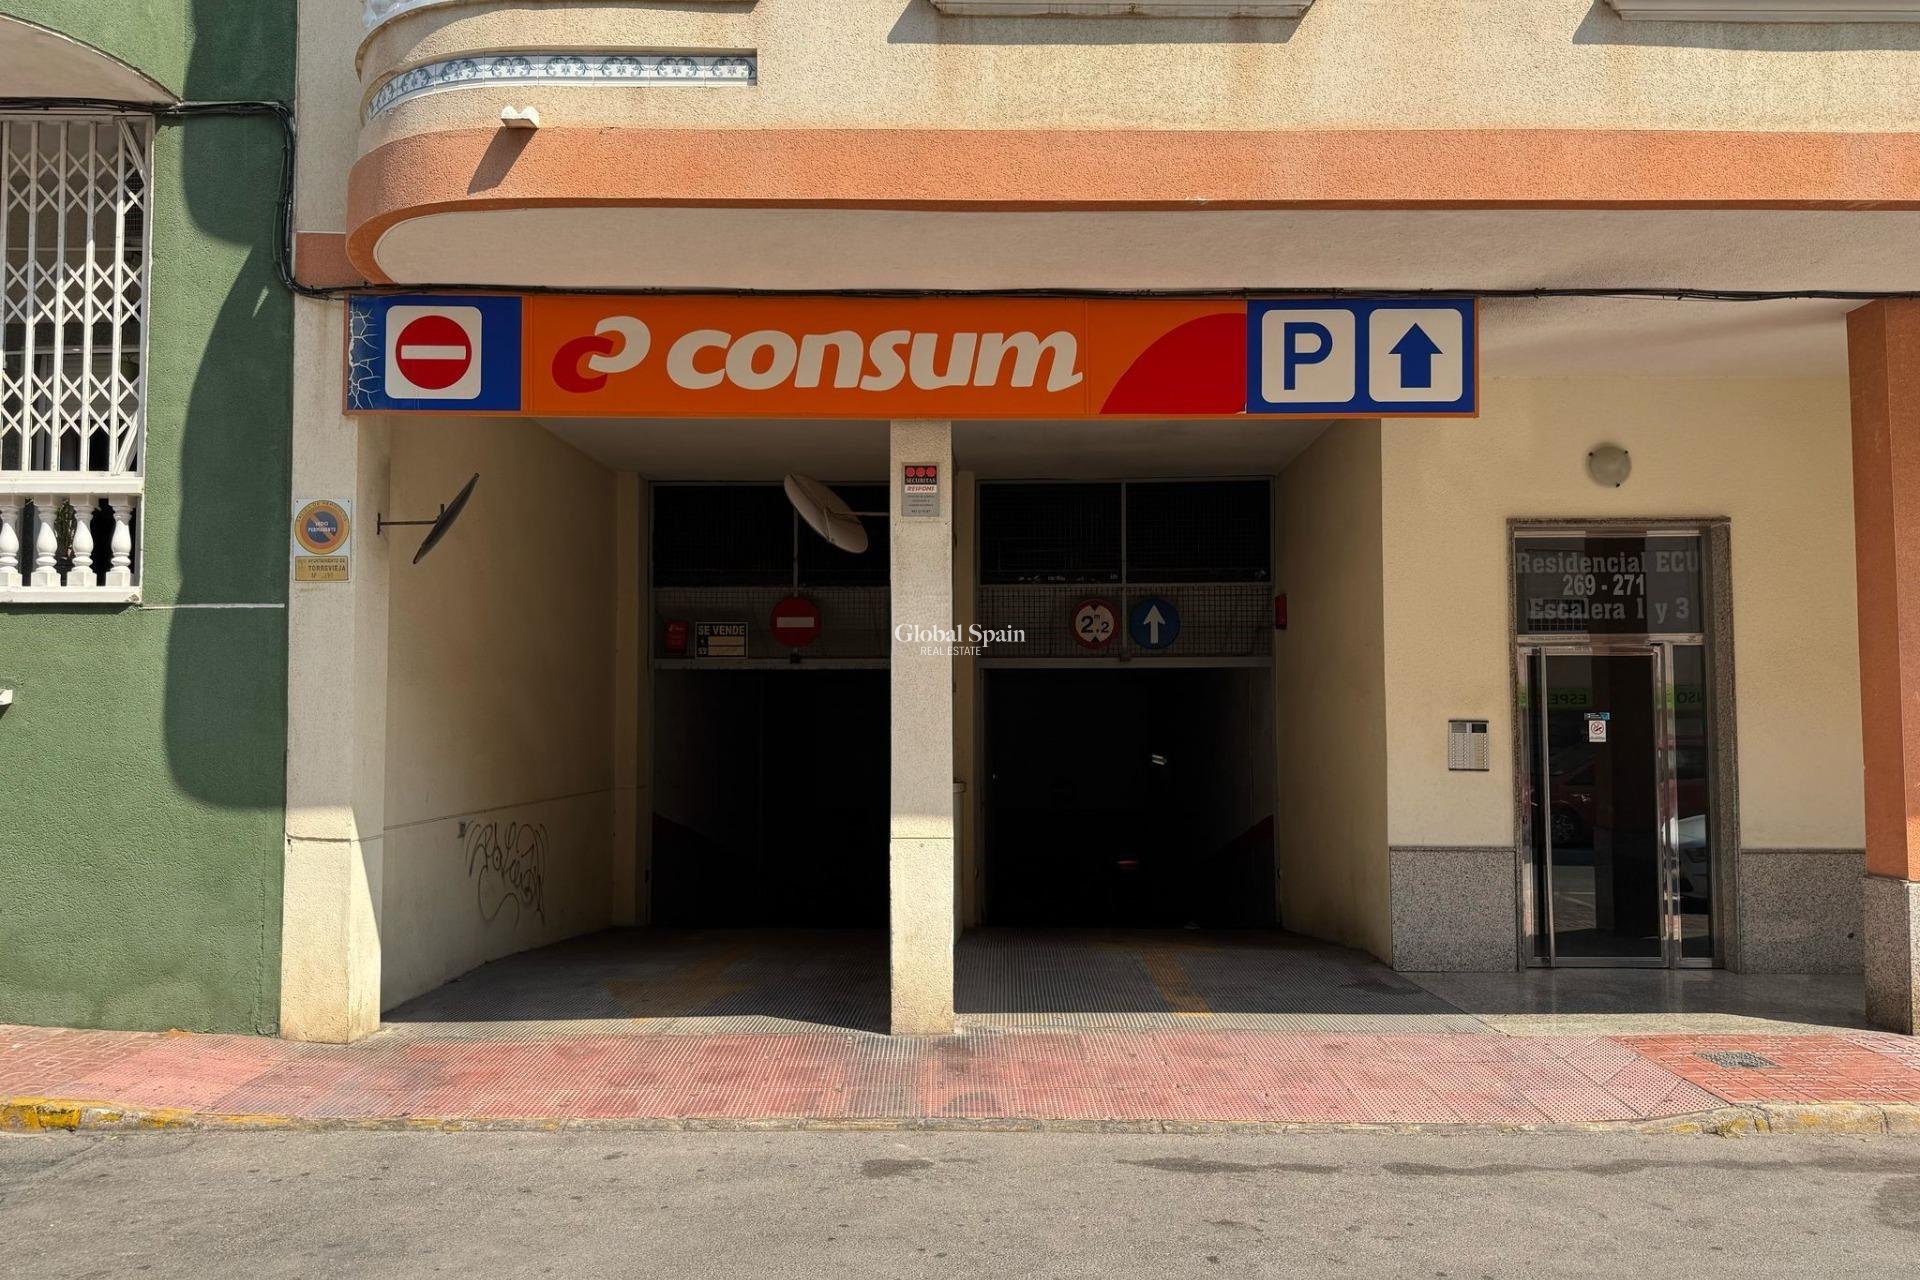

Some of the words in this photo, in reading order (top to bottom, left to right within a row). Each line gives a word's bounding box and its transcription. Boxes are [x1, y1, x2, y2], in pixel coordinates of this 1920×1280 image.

[666, 329, 1083, 392] consum
[1283, 322, 1333, 391] P
[1516, 551, 1647, 574] Residencial
[1562, 574, 1596, 596] 269
[1612, 574, 1645, 596] 271
[1529, 597, 1626, 620] Escalera
[1655, 602, 1668, 625] y
[1676, 597, 1690, 620] 3
[697, 625, 710, 636] SE
[711, 625, 745, 636] VENDE
